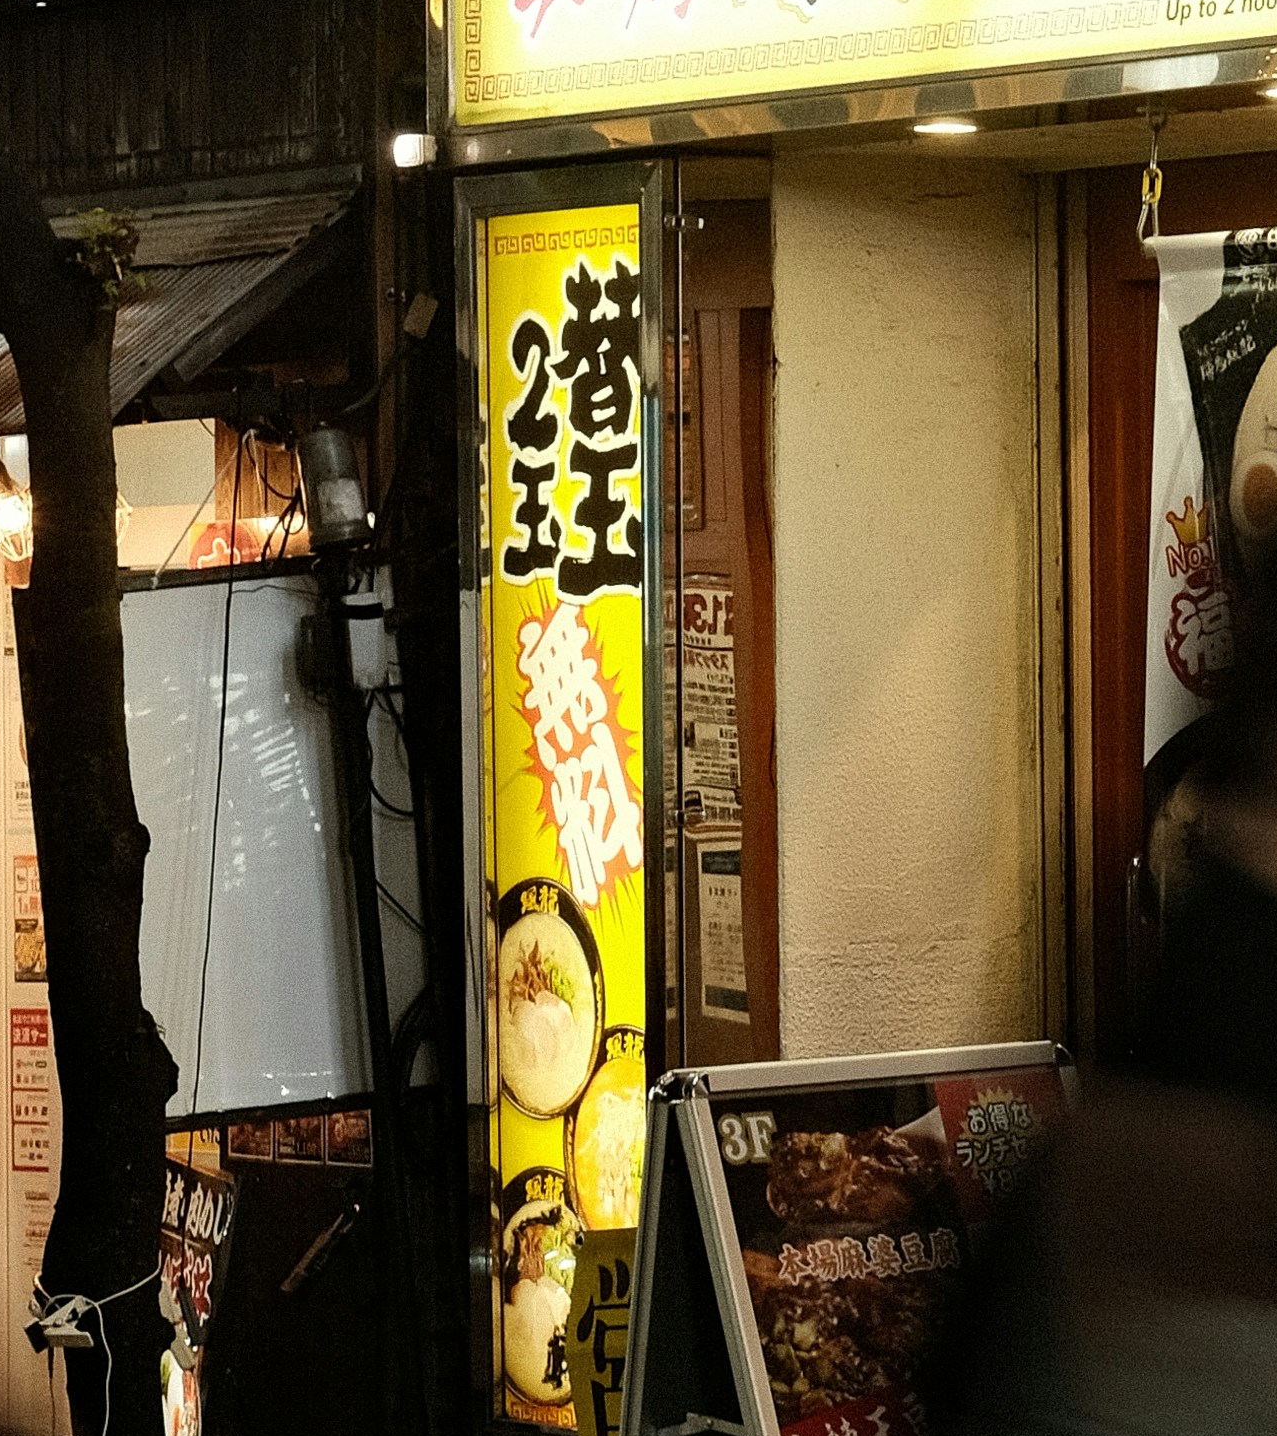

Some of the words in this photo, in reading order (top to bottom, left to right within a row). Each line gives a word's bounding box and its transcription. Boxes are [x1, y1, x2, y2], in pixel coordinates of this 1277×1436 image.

[1166, 0, 1191, 26] Up
[520, 886, 560, 917] 風龍
[721, 1111, 777, 1165] 3F
[778, 1230, 961, 1283] 本場麻婆豆腐
